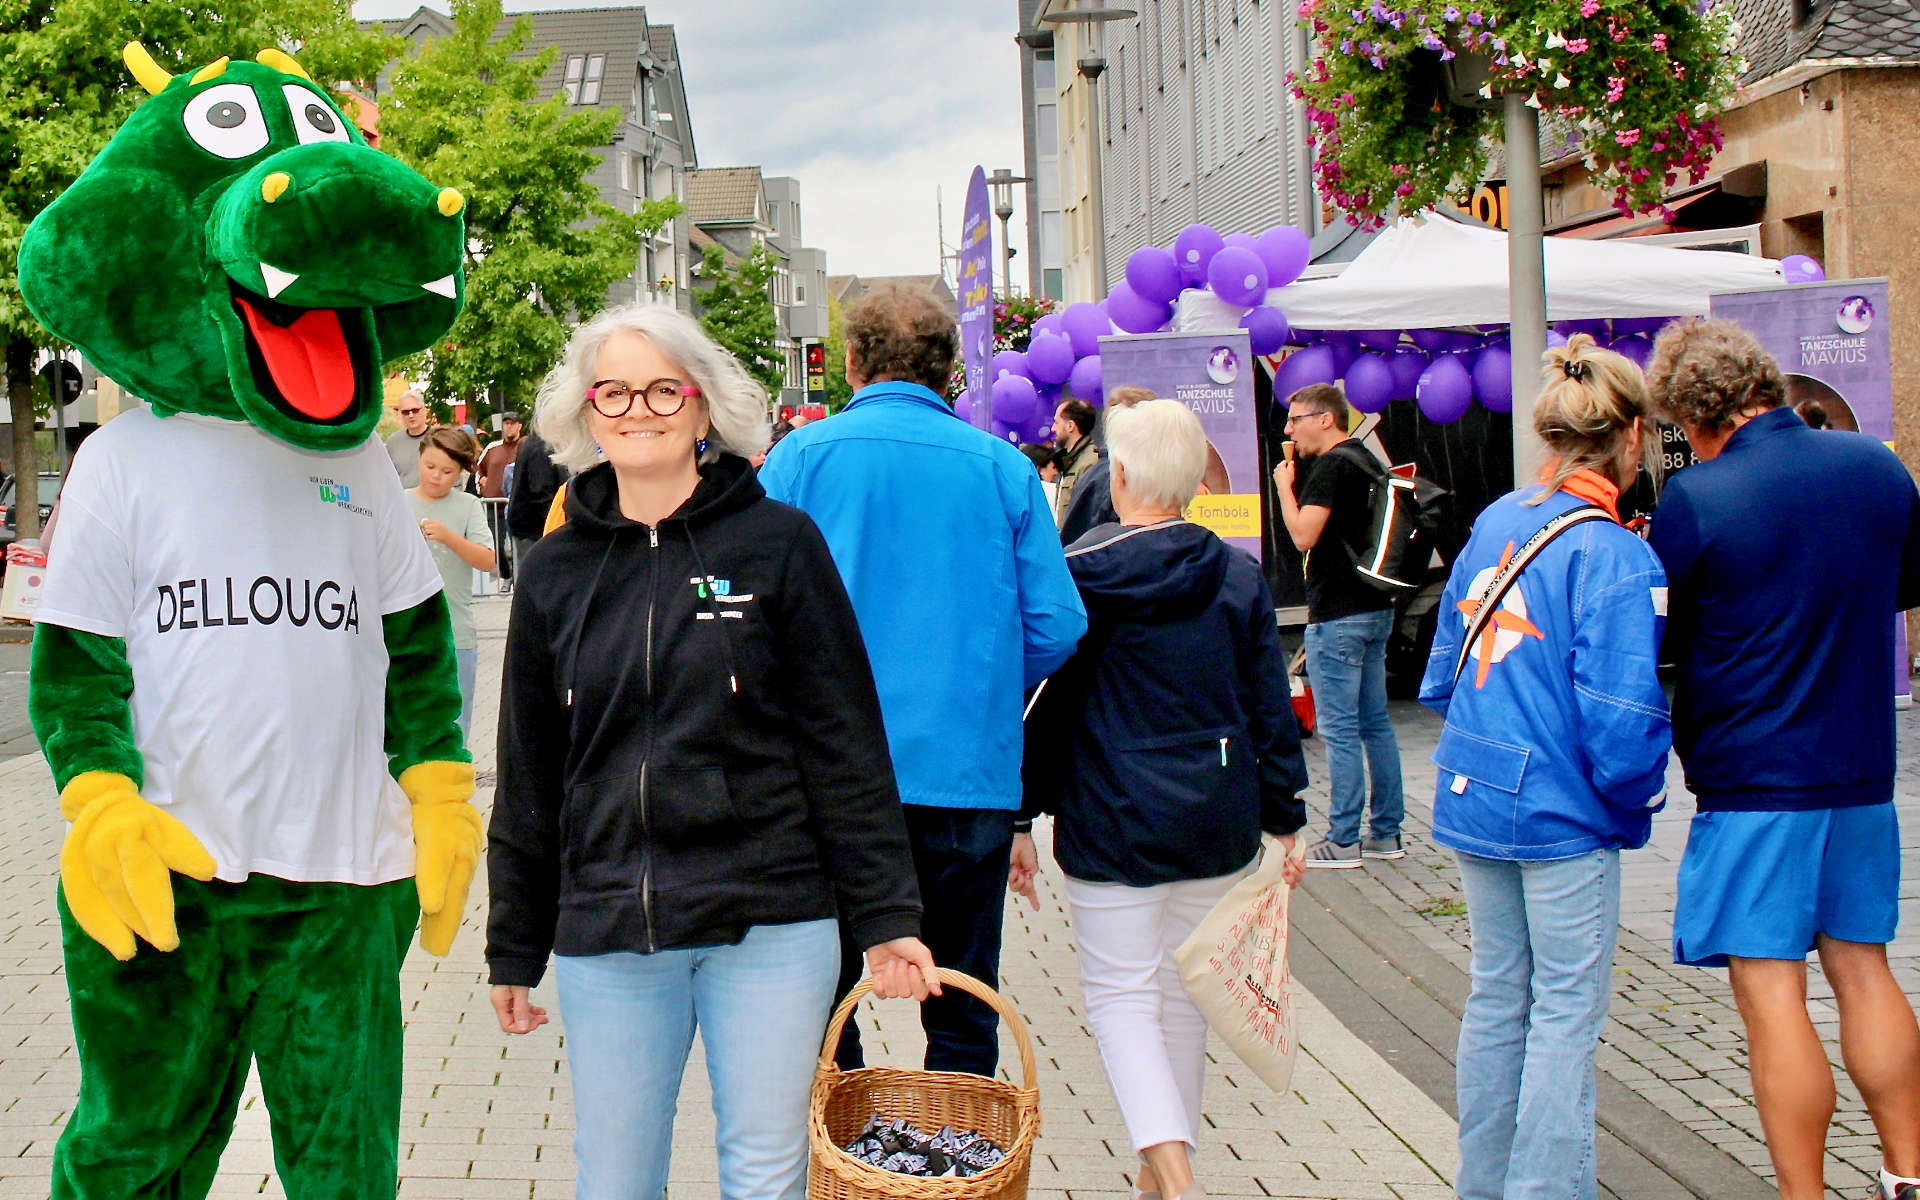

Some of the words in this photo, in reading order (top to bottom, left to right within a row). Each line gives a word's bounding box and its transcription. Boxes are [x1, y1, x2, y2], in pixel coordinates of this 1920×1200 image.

[1800, 338, 1866, 351] TANZSCHULE
[1801, 349, 1867, 367] MAVIUS
[1176, 388, 1235, 400] TANZSCHULE
[1198, 504, 1249, 519] Tombola
[157, 575, 359, 634] DELLOUGA
